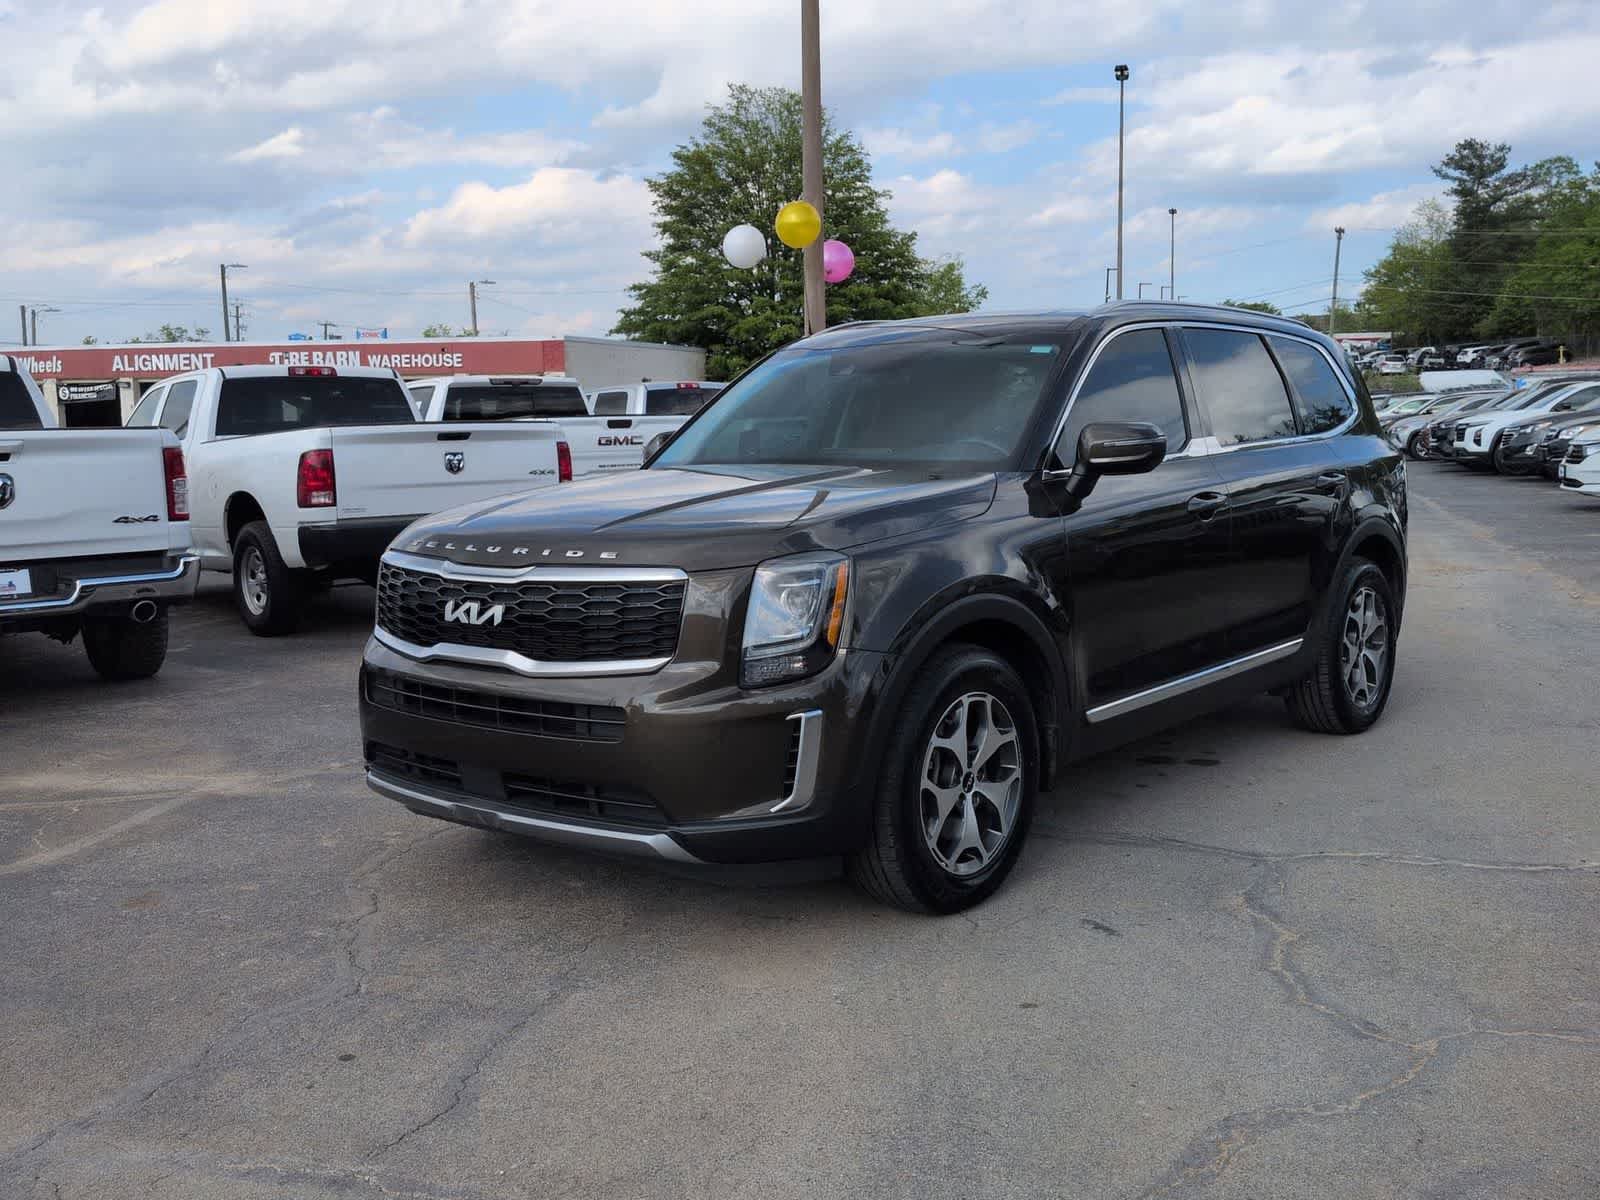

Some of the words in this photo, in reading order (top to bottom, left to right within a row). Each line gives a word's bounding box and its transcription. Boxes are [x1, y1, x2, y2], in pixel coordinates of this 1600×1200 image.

[112, 353, 215, 372] ALIGNMENT
[312, 351, 361, 368] BARN
[367, 353, 463, 368] WAREHOUSE
[598, 435, 644, 446] GMC
[410, 539, 619, 560] TELLURIDE
